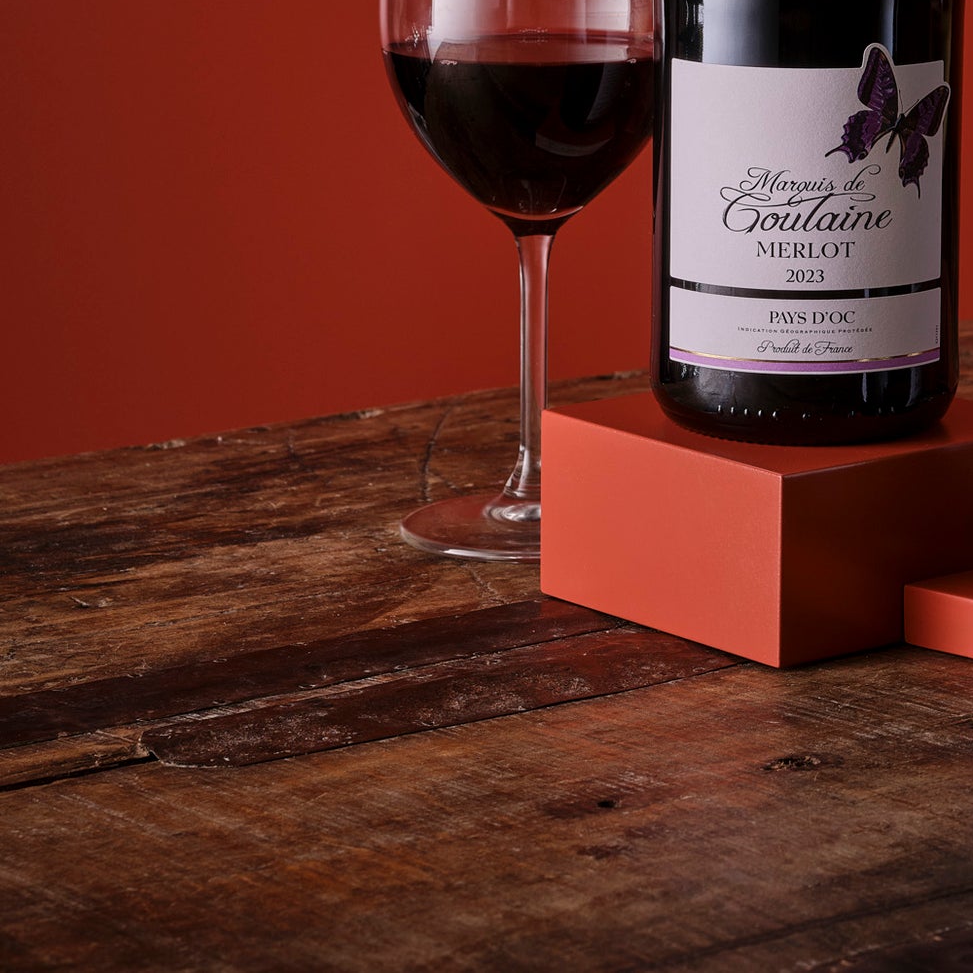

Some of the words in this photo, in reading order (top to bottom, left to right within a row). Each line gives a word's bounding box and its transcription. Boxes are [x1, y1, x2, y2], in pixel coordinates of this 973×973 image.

[739, 166, 837, 207] Marquis
[843, 163, 882, 192] de
[719, 186, 893, 235] Goulaine
[756, 240, 856, 259] MERLOT
[785, 268, 825, 284] 2023
[769, 310, 807, 325] PAYS
[812, 310, 856, 325] D'OC
[737, 326, 778, 334] INDICATION
[756, 338, 801, 354] Produit
[802, 342, 813, 354] de
[814, 340, 854, 356] France
